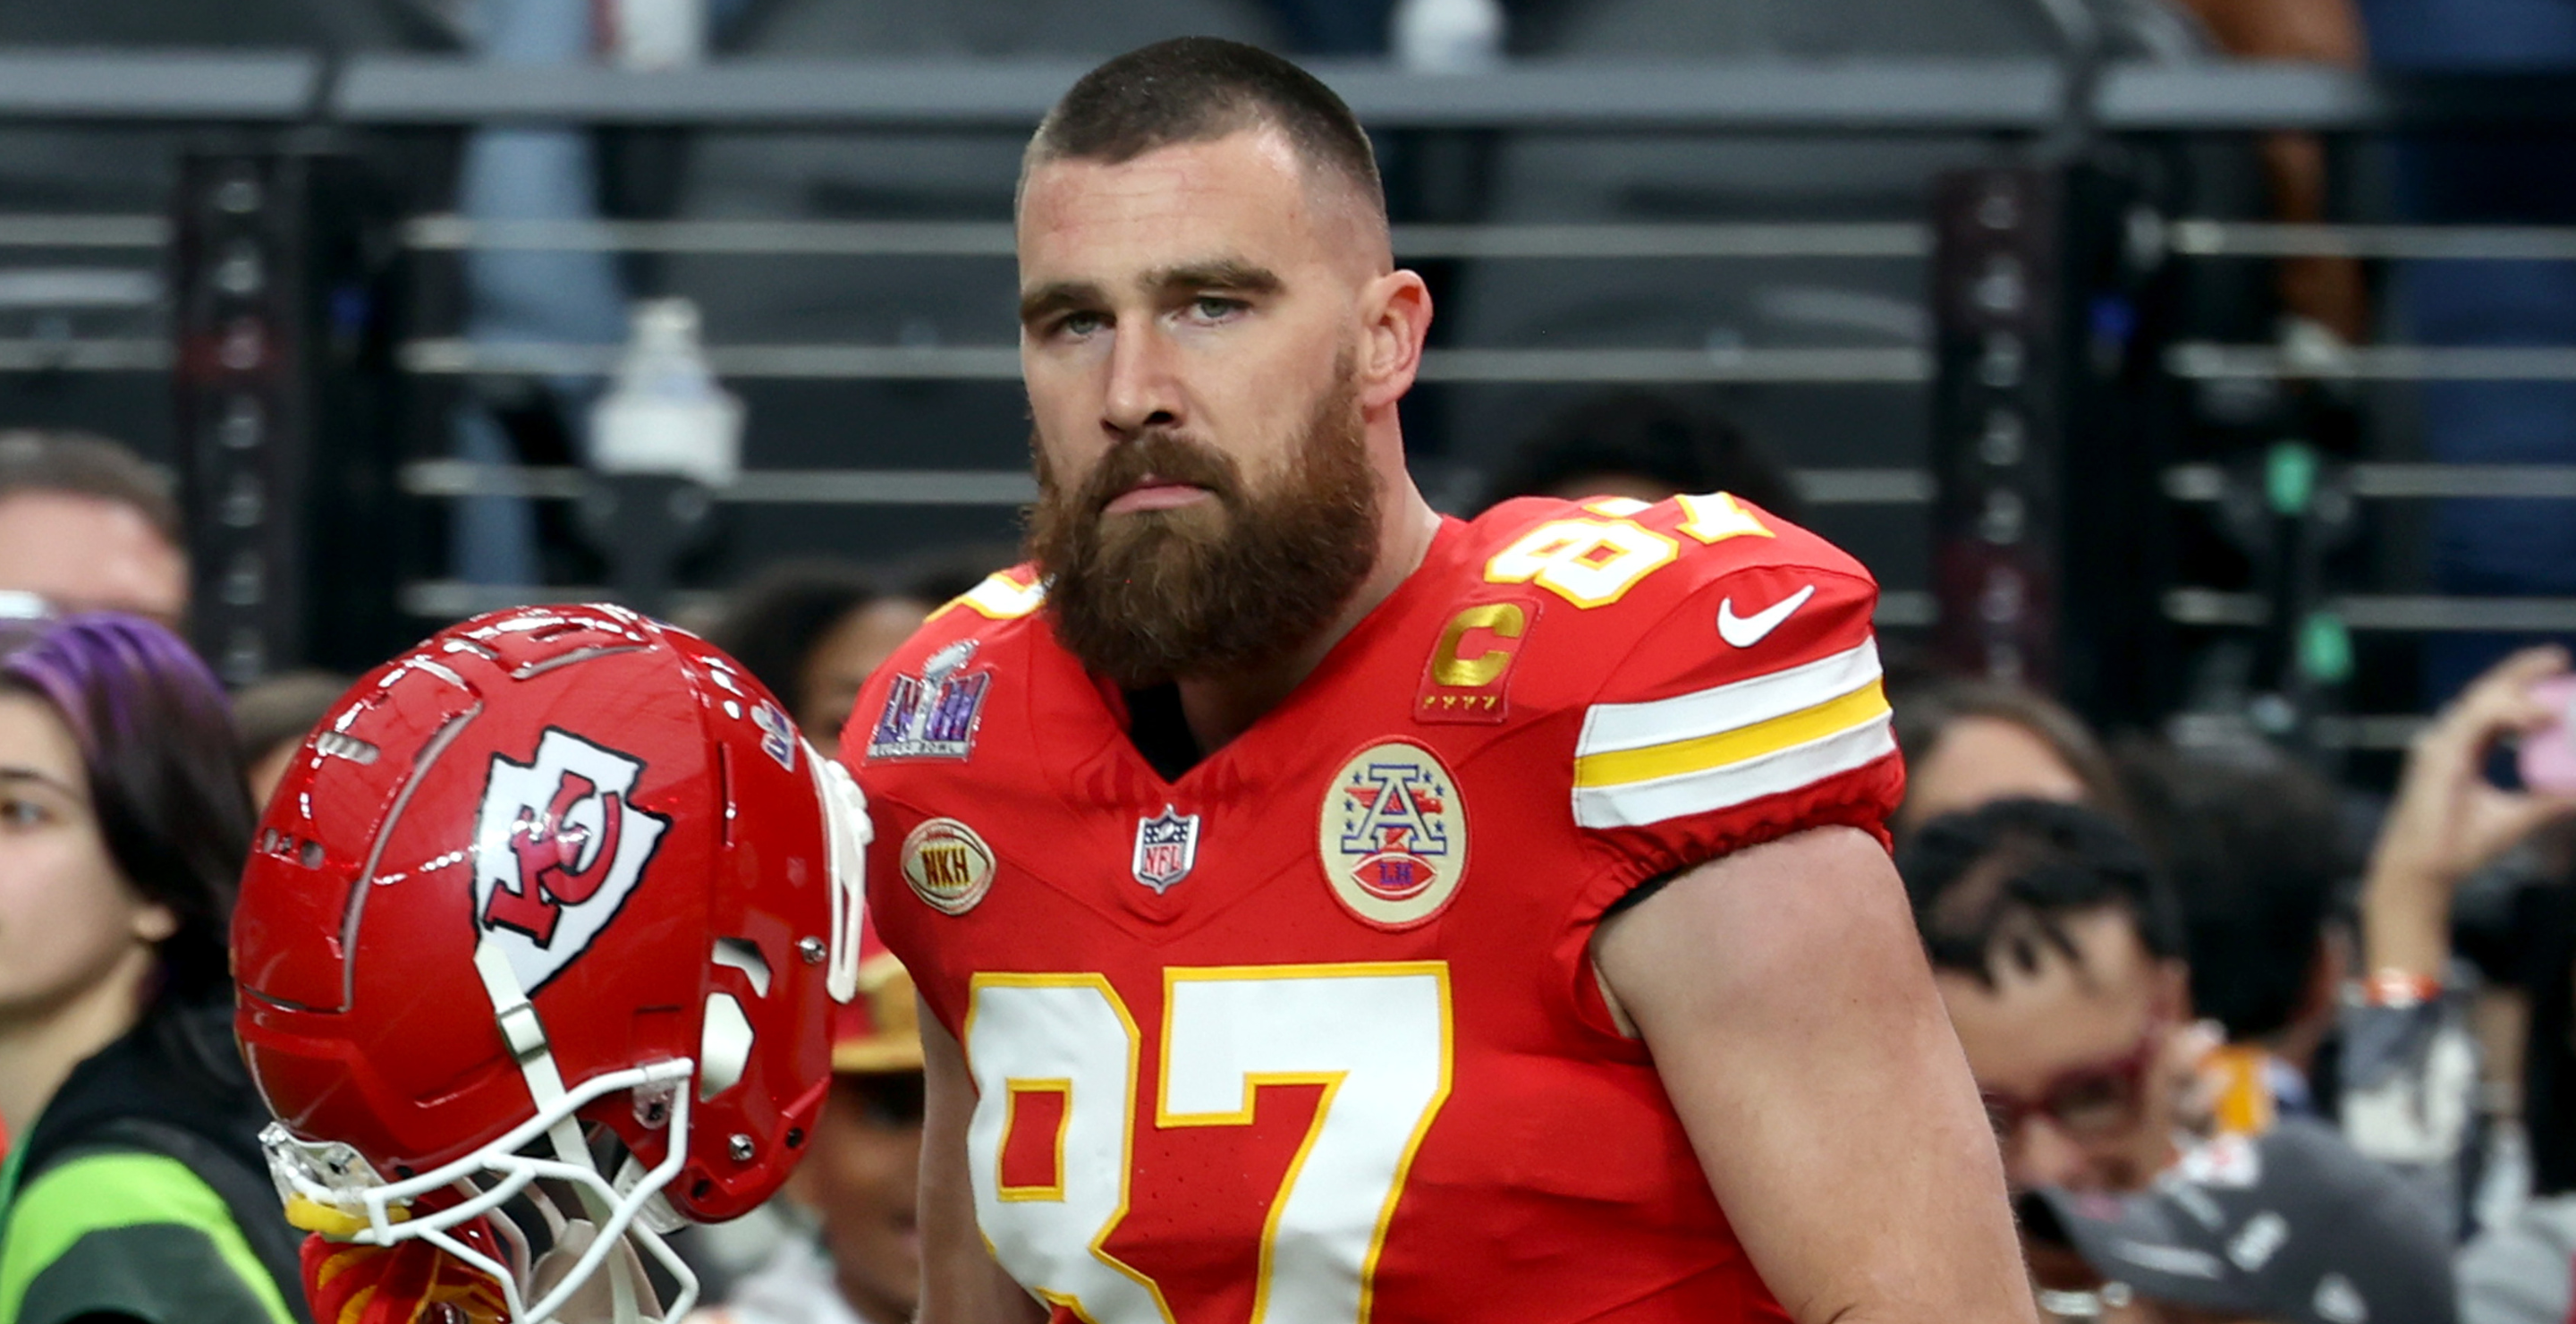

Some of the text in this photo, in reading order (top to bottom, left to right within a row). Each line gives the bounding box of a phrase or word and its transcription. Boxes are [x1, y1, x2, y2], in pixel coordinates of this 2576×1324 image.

[1434, 603, 1525, 686] C
[1341, 764, 1446, 854] A
[484, 769, 623, 951] KC
[919, 845, 971, 887] NKH
[1144, 845, 1182, 877] NFL
[1379, 863, 1412, 884] LH
[964, 961, 1453, 1324] 87
